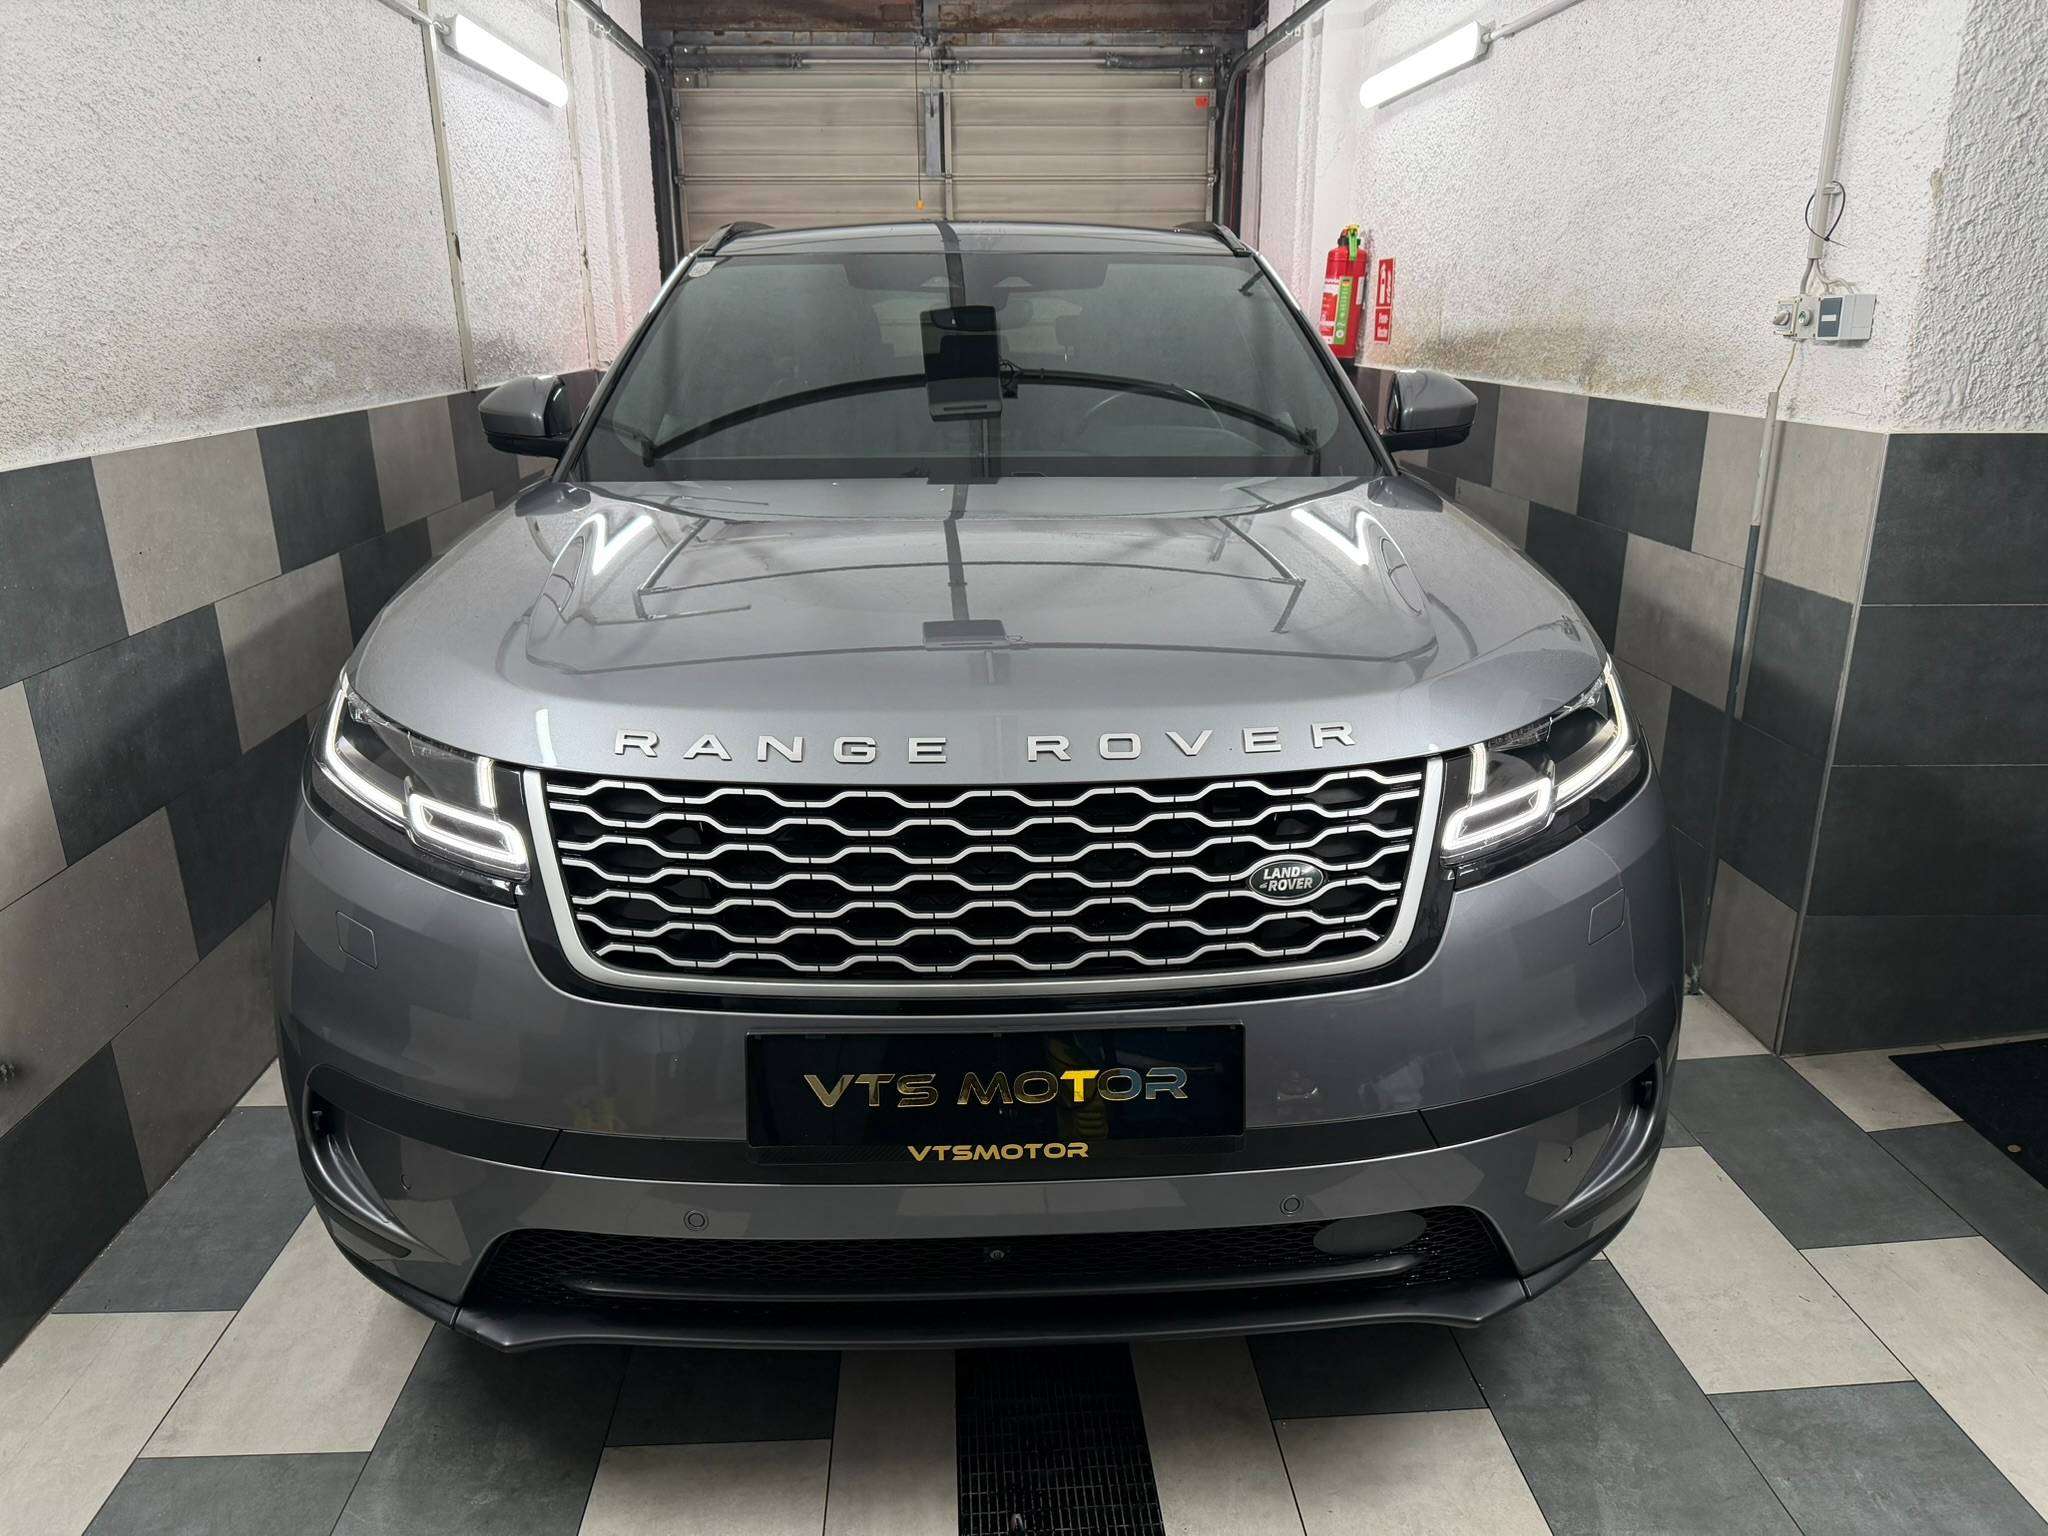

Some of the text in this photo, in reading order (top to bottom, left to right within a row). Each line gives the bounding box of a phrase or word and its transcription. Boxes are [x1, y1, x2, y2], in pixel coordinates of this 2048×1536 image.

[614, 722, 1356, 764] RANGE ROVER
[1263, 867, 1300, 880] LAND
[1268, 877, 1313, 892] ROVER
[804, 1067, 1188, 1108] VTS MOTOR
[907, 1142, 1089, 1162] VTSMOTOR
